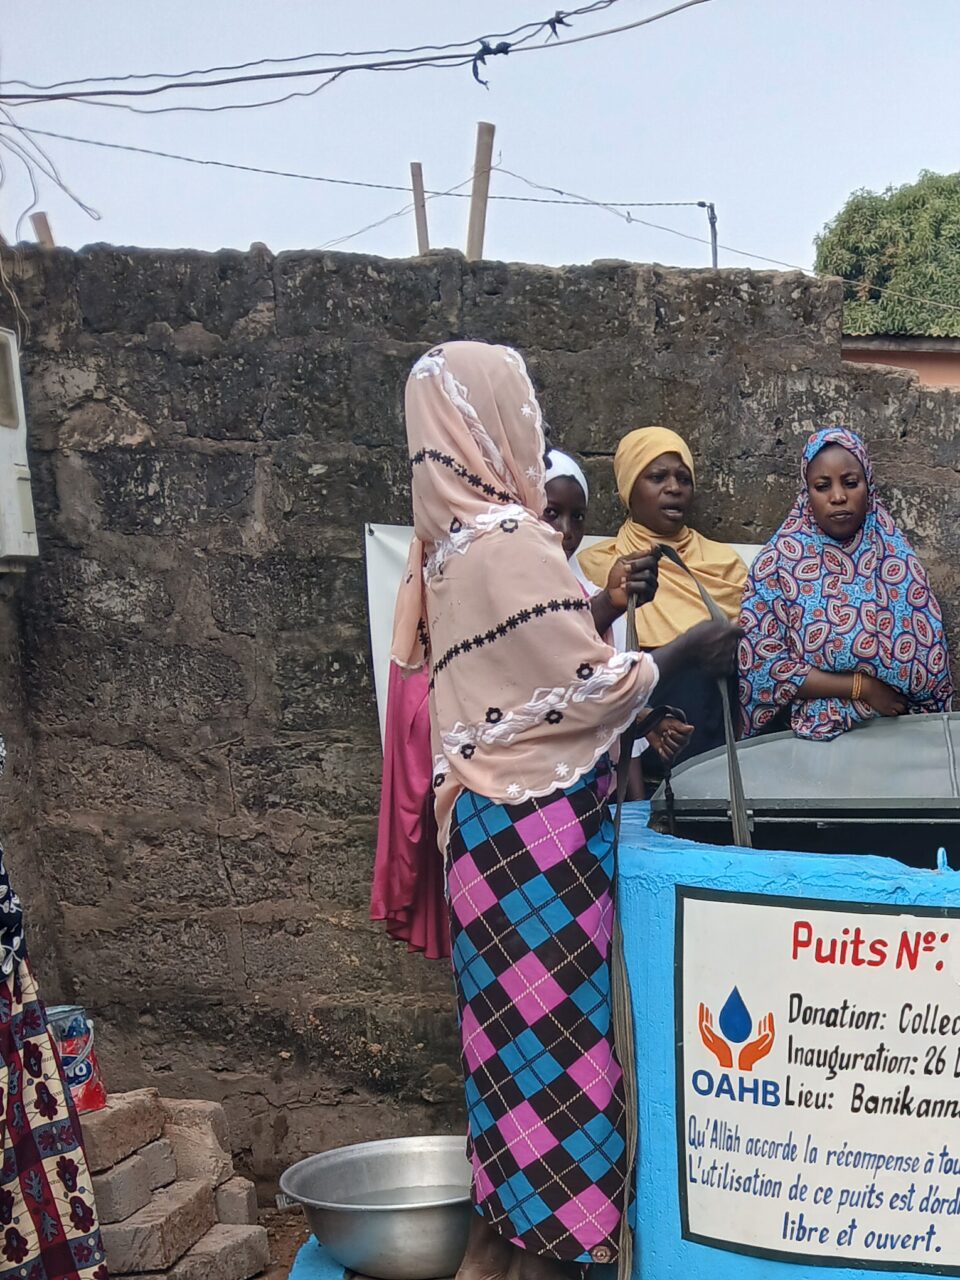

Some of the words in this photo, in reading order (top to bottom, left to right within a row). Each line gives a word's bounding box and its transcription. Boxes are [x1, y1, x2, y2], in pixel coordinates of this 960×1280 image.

[792, 920, 889, 967] Puits
[788, 993, 887, 1031] Donation:
[787, 1034, 919, 1081] Inauguration:
[923, 1045, 947, 1076] 26
[691, 1069, 781, 1107] OAHB
[784, 1075, 835, 1110] Lieu:
[745, 1131, 798, 1162] accorde
[803, 1133, 818, 1164] la
[826, 1141, 920, 1180] récompense
[923, 1151, 935, 1174] à
[688, 1154, 783, 1199] L'utilisation
[788, 1173, 808, 1201] de
[813, 1186, 834, 1206] ce
[836, 1182, 885, 1215] puits
[889, 1182, 916, 1213] est
[782, 1211, 830, 1244] libre
[836, 1218, 858, 1247] et
[863, 1223, 942, 1253] ouvert.
